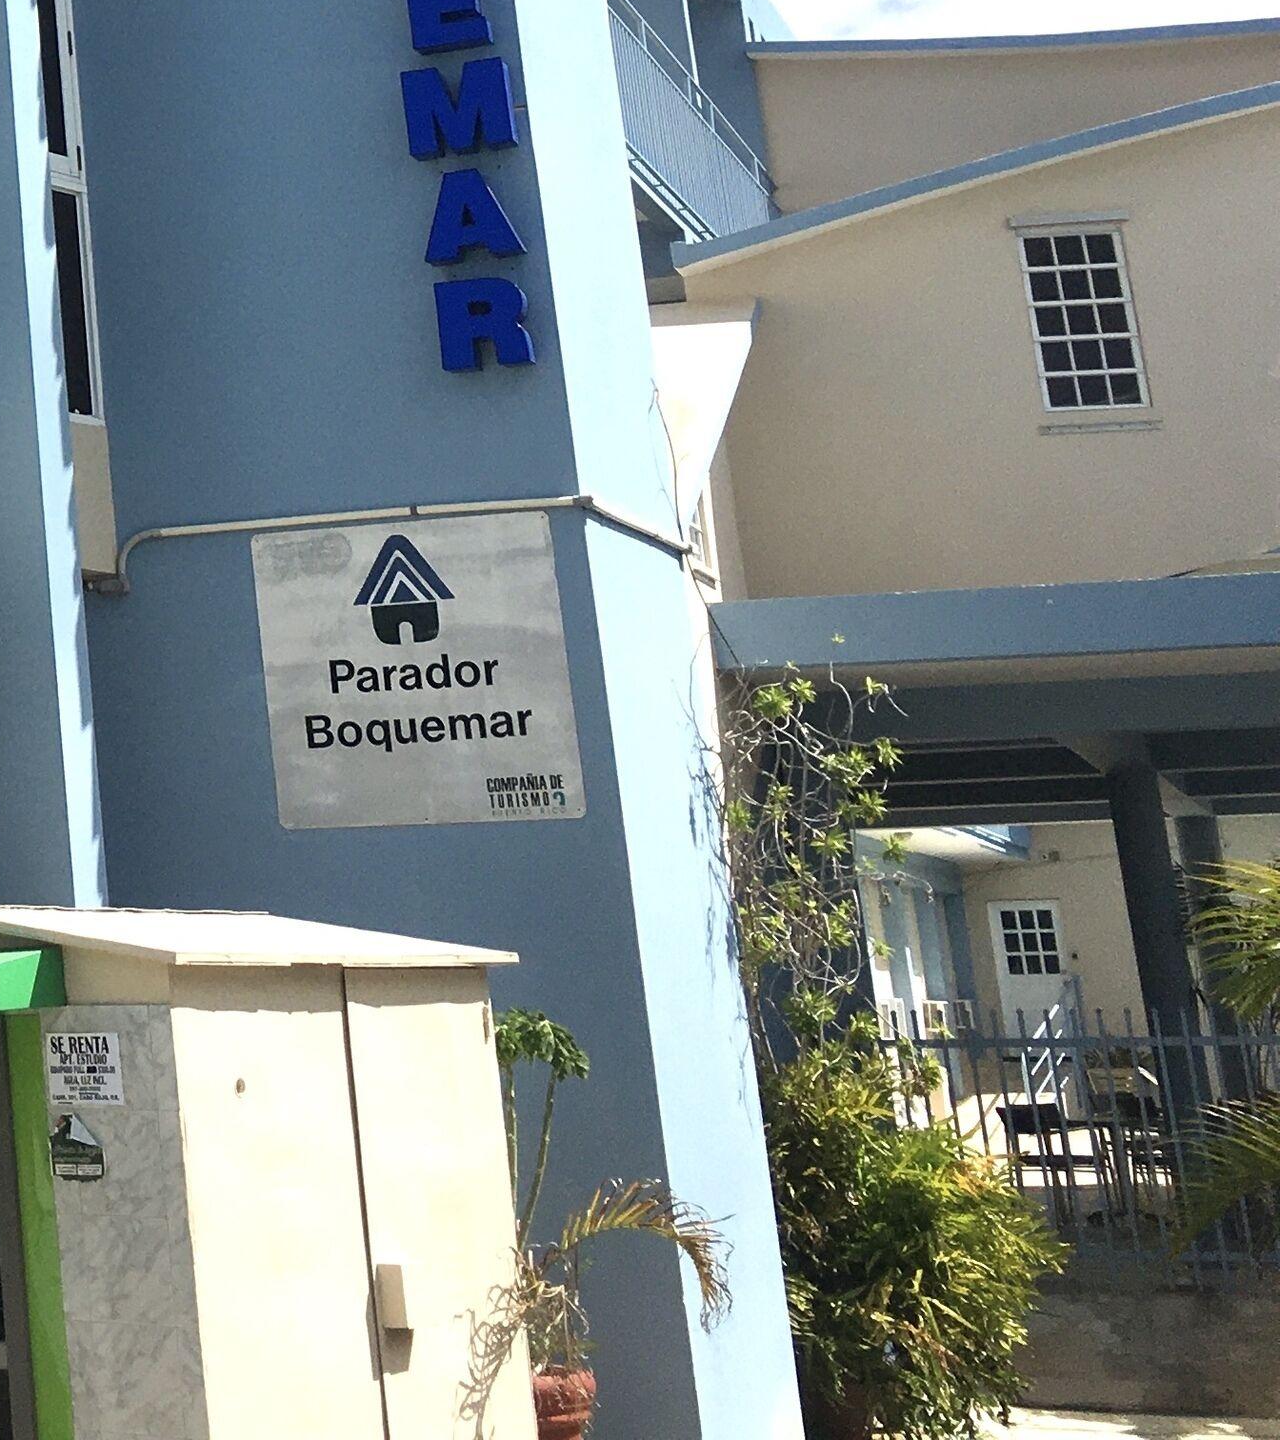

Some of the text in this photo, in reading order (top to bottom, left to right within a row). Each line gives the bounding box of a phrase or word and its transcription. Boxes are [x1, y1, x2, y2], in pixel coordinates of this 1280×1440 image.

[329, 654, 499, 694] Parador
[305, 708, 533, 752] Boquemar
[549, 774, 564, 790] DE
[489, 791, 550, 809] TURISMO
[50, 1036, 109, 1054] SE RENTA
